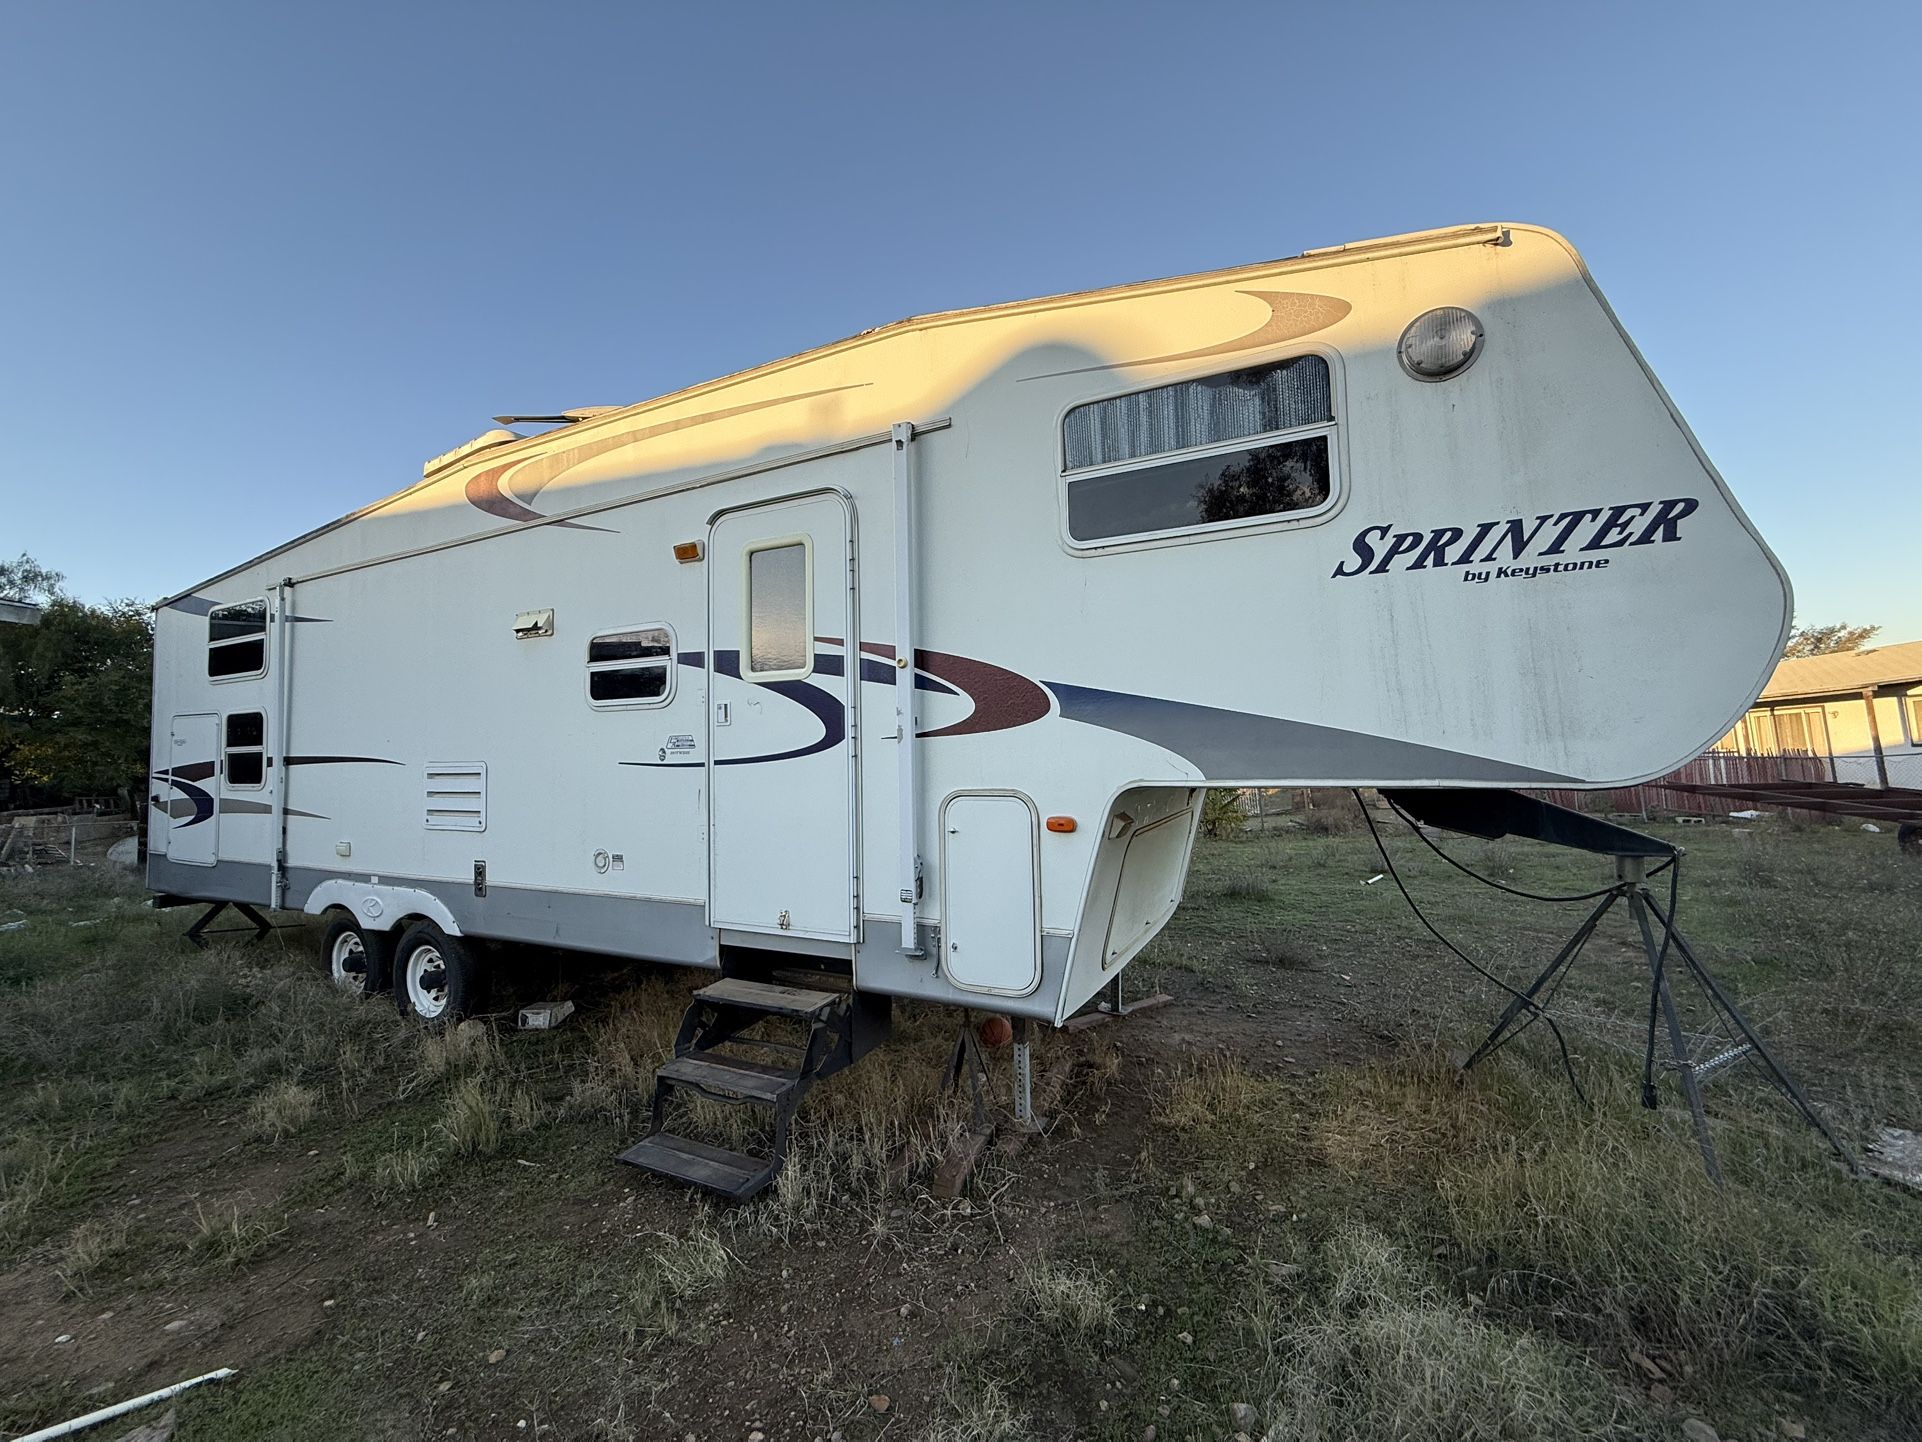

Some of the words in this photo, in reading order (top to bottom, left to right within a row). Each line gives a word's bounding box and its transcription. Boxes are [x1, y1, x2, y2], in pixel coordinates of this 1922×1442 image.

[1331, 497, 1700, 579] SPRINTER
[1463, 570, 1491, 584] by
[1495, 558, 1610, 579] Keystone
